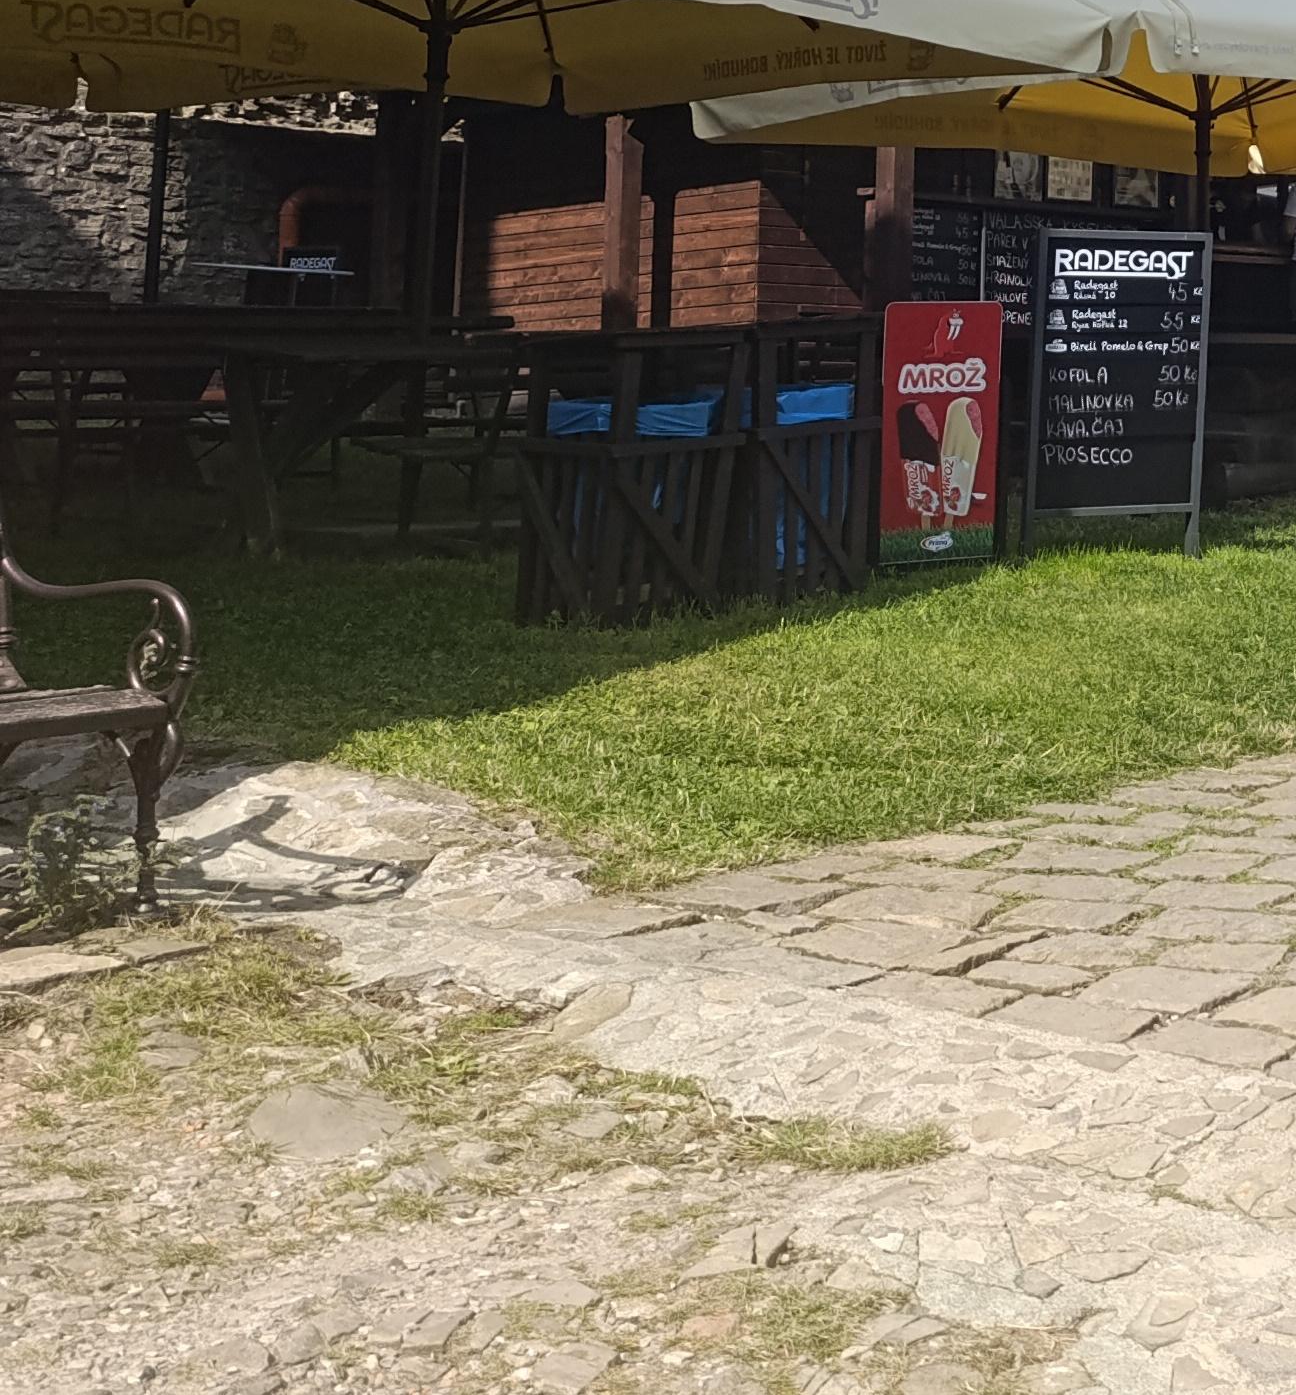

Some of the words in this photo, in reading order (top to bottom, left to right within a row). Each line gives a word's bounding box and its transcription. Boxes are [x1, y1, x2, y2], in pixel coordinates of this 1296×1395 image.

[290, 256, 336, 272] RADEGAST
[1054, 249, 1194, 279] RADEGAST
[986, 270, 1033, 288] HRANOLK
[1074, 279, 1118, 293] Radegast
[1105, 291, 1116, 300] 10
[1168, 281, 1188, 301] 45
[1072, 308, 1116, 322] Radegast
[1160, 311, 1184, 330] 55
[1101, 340, 1135, 352] Pomelo
[1144, 341, 1169, 355] Grep
[1170, 337, 1188, 353] 50
[901, 361, 983, 390] MROŽ
[1050, 366, 1108, 385] KOFOLA
[1158, 365, 1181, 382] 50
[1049, 394, 1134, 413] MALINOVKA
[1153, 389, 1173, 407] 50
[1041, 443, 1133, 466] PROSECCO
